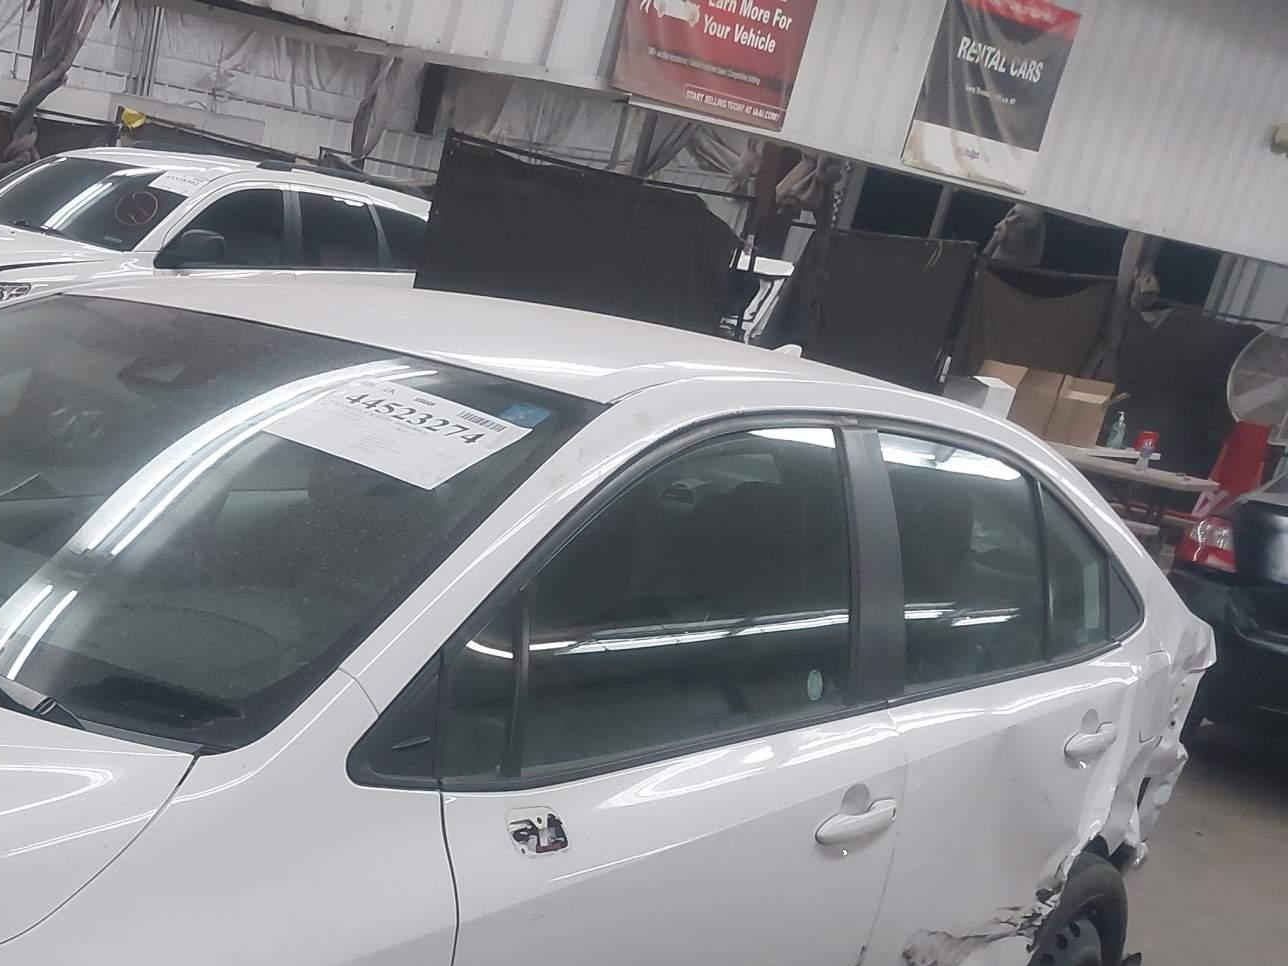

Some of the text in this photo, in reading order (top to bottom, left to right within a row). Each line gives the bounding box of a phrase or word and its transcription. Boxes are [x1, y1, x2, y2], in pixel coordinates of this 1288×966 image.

[703, 14, 776, 54] Your Vehicle
[739, 0, 771, 24] More
[772, 8, 793, 31] For
[957, 36, 1044, 83] RENTAL CARS
[686, 90, 705, 102] START
[704, 95, 727, 109] SELLING
[727, 100, 745, 112] TODAY
[346, 393, 486, 444] 44523274
